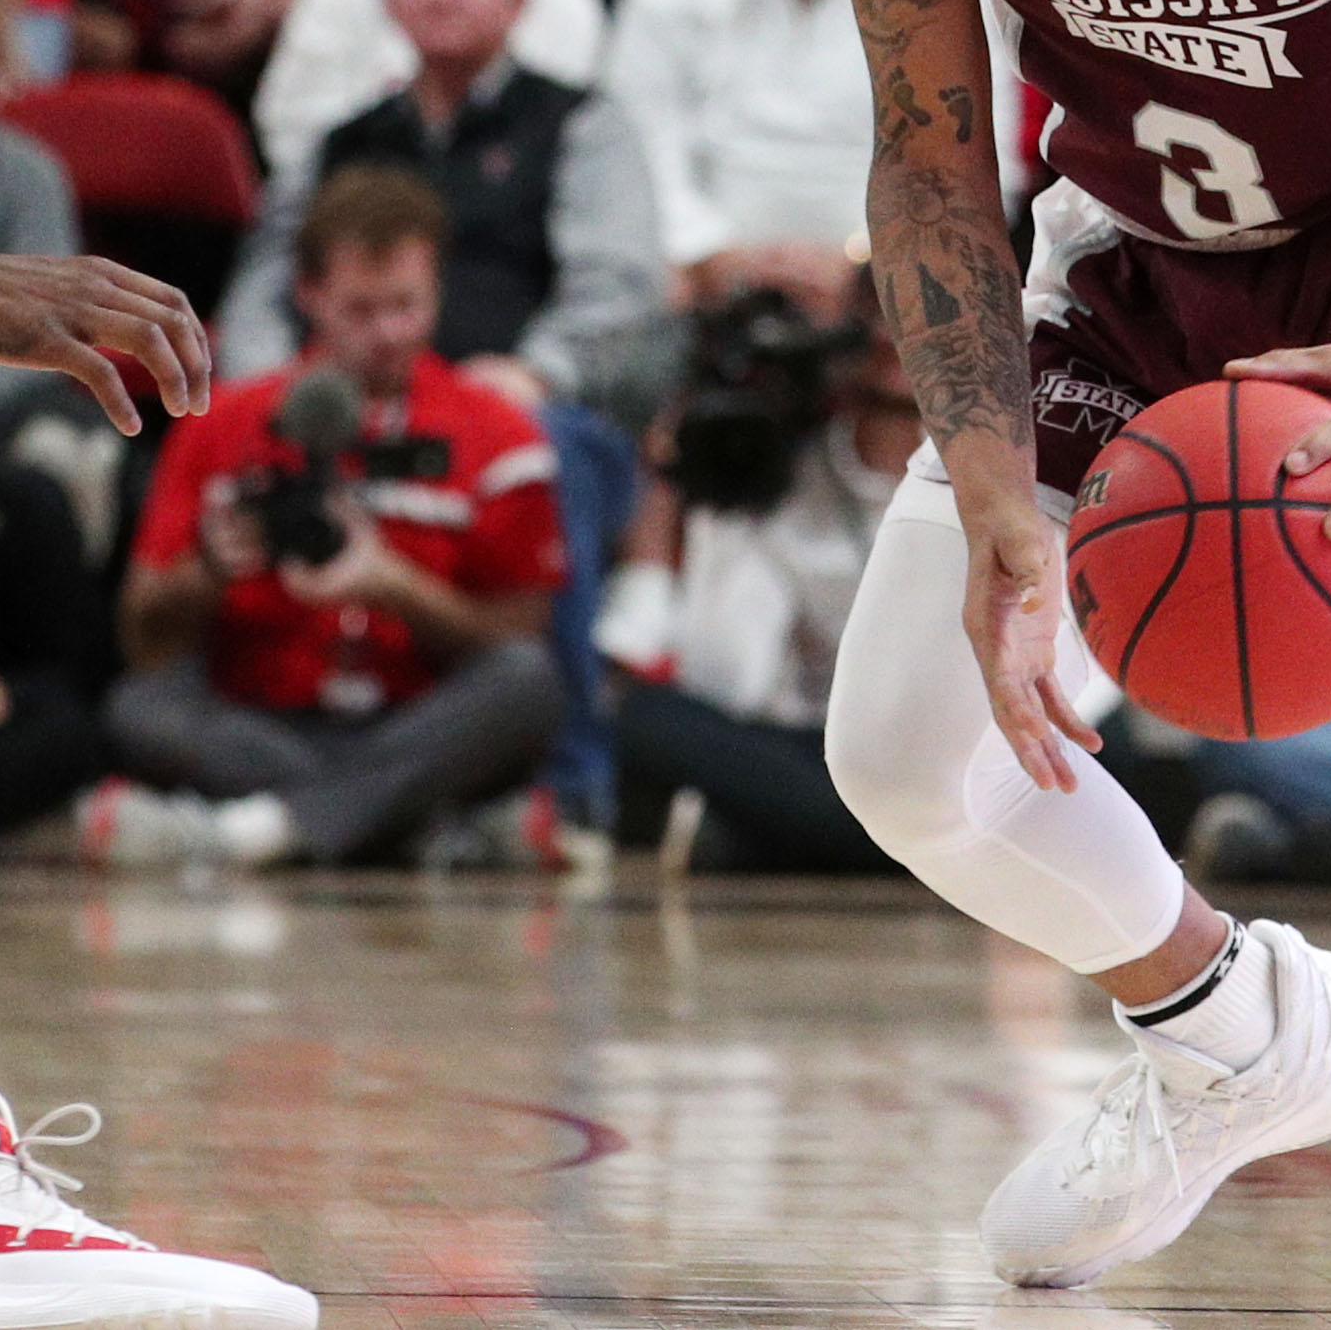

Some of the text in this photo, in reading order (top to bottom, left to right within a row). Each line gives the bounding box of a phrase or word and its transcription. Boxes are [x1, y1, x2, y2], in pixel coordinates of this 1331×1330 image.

[1086, 22, 1249, 79] STATE
[1131, 99, 1284, 240] 3
[1060, 380, 1143, 418] STAT
